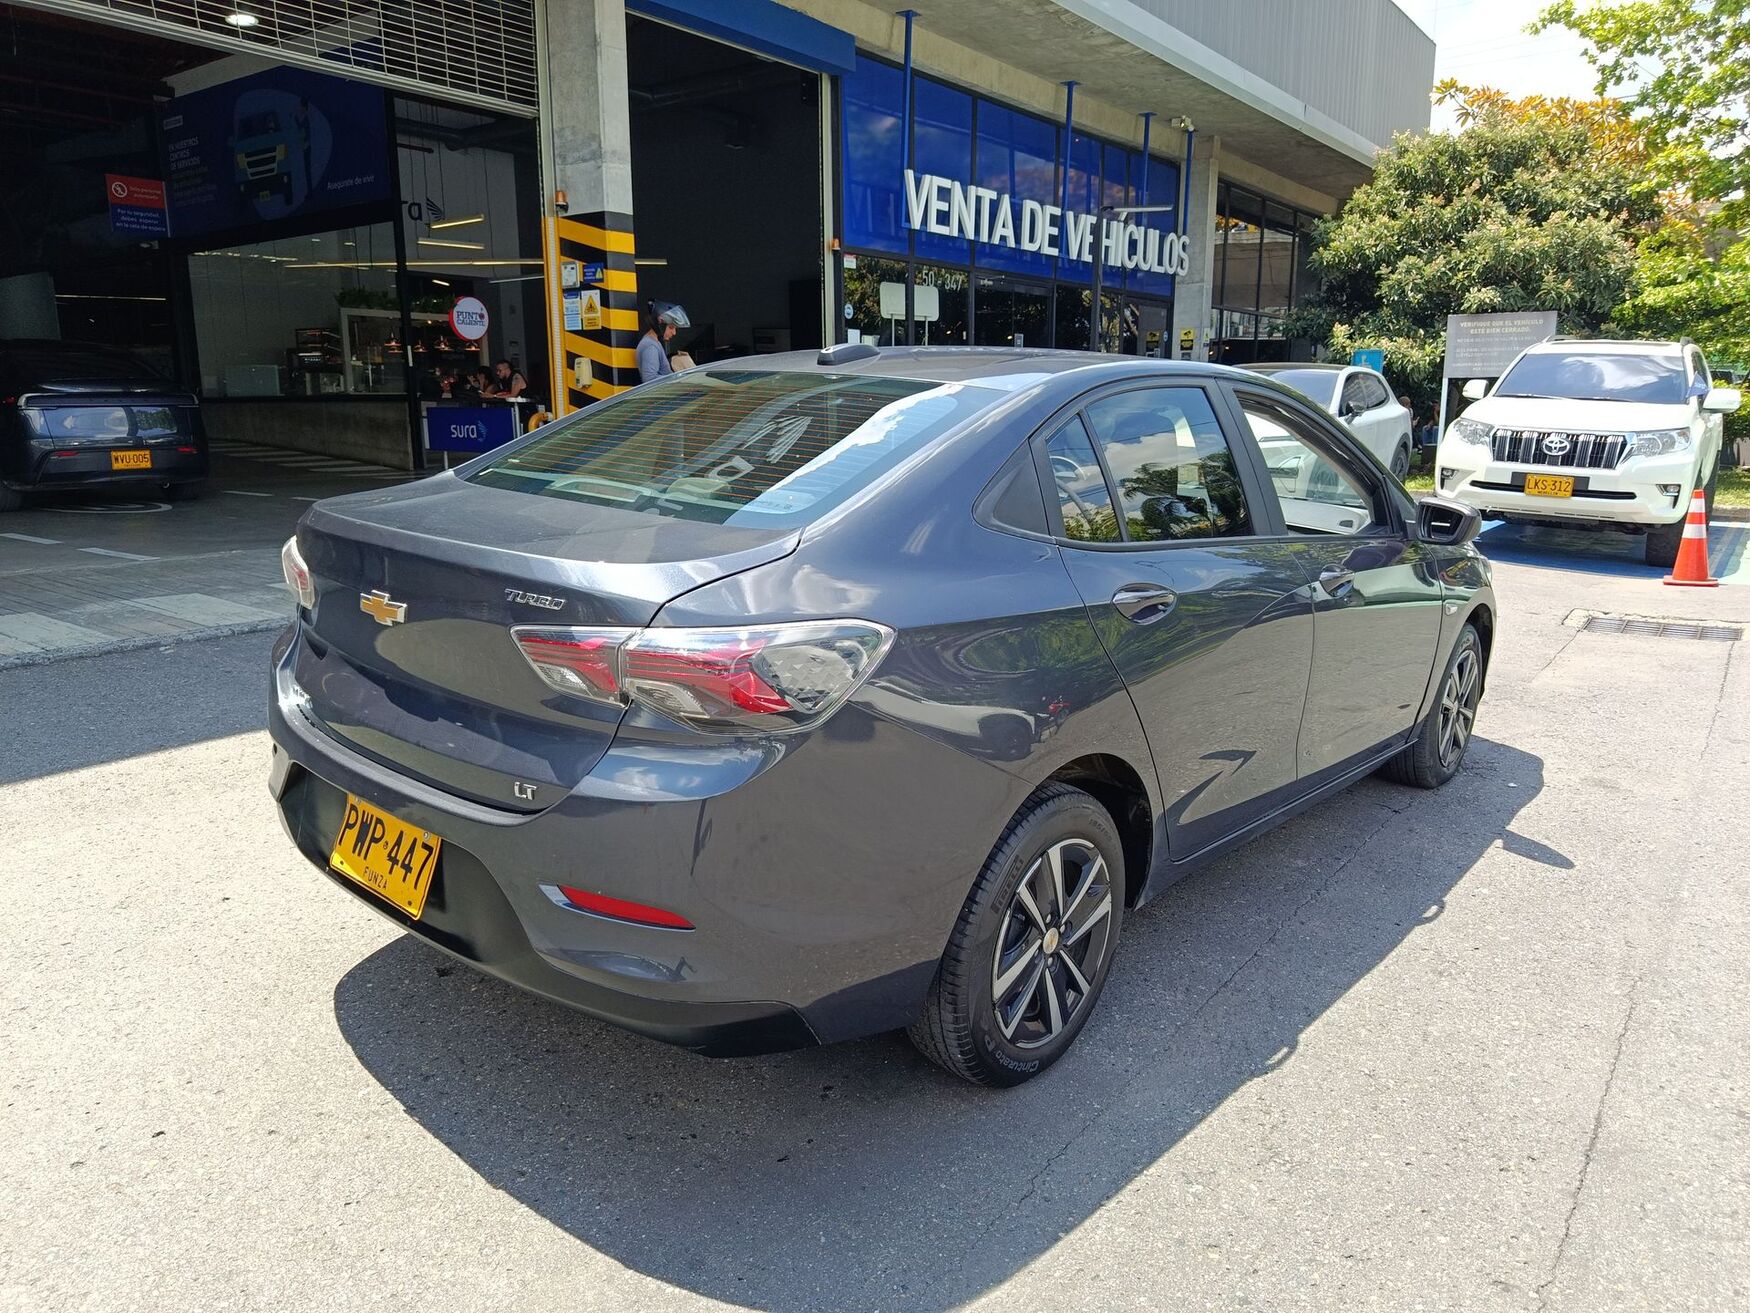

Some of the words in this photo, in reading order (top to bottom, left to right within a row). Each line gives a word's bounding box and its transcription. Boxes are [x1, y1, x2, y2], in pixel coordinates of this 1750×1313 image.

[904, 169, 1016, 248] VENTA
[1020, 199, 1062, 257] DE
[1066, 210, 1191, 277] VEHÍCULOS
[922, 270, 935, 287] 50
[944, 274, 962, 291] 347
[450, 424, 477, 439] sura
[504, 588, 566, 611] TURBO
[514, 781, 537, 801] LT
[363, 866, 389, 891] FUNZA
